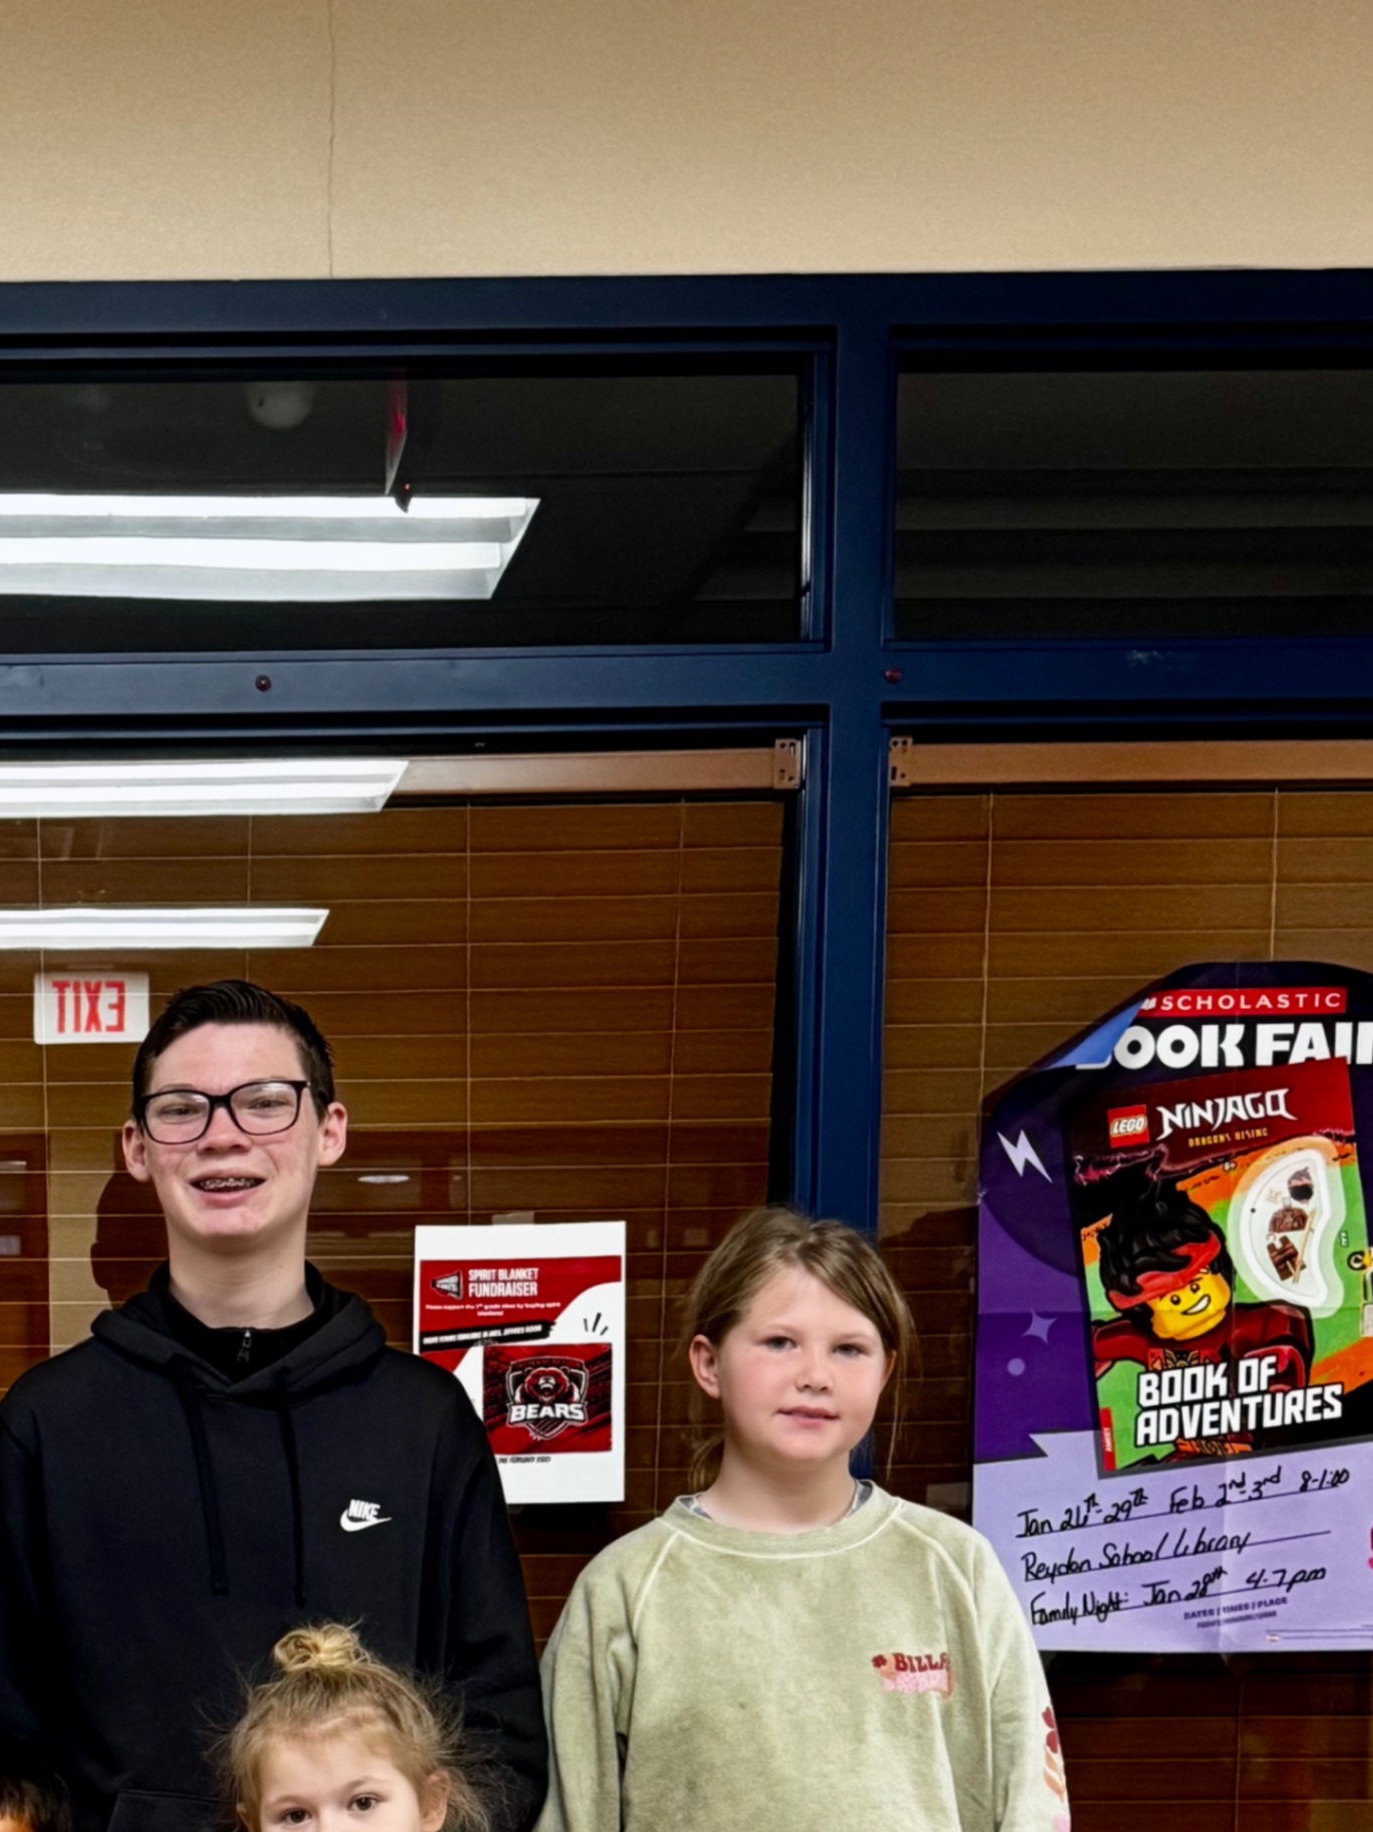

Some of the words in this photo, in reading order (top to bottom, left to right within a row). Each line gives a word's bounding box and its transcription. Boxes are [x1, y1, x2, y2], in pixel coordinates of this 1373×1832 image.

[1161, 993, 1341, 1011] SCHOLASTIC
[1076, 1023, 1245, 1070] OOK
[1111, 1116, 1147, 1136] LEGO
[1156, 1088, 1298, 1141] NINJAGO
[468, 1268, 496, 1281] SPIRIT
[498, 1267, 539, 1281] BLANKET
[468, 1282, 538, 1298] FUNDRAISER
[1139, 1362, 1227, 1408] BOOK
[1238, 1355, 1276, 1394] OF
[510, 1402, 585, 1423] BEARS
[1137, 1384, 1343, 1446] ADVENTURES
[348, 1499, 381, 1521] NIKE
[1016, 1507, 1054, 1538] Jan
[1169, 1484, 1205, 1514] Feb
[1020, 1546, 1093, 1585] Reydon
[1099, 1532, 1169, 1570] School
[1173, 1526, 1252, 1555] Library
[1030, 1590, 1079, 1626] Family
[1141, 1579, 1182, 1607] Jan
[1183, 1608, 1215, 1620] DATES
[1222, 1602, 1250, 1614] TIMES
[1257, 1597, 1288, 1608] PLACE
